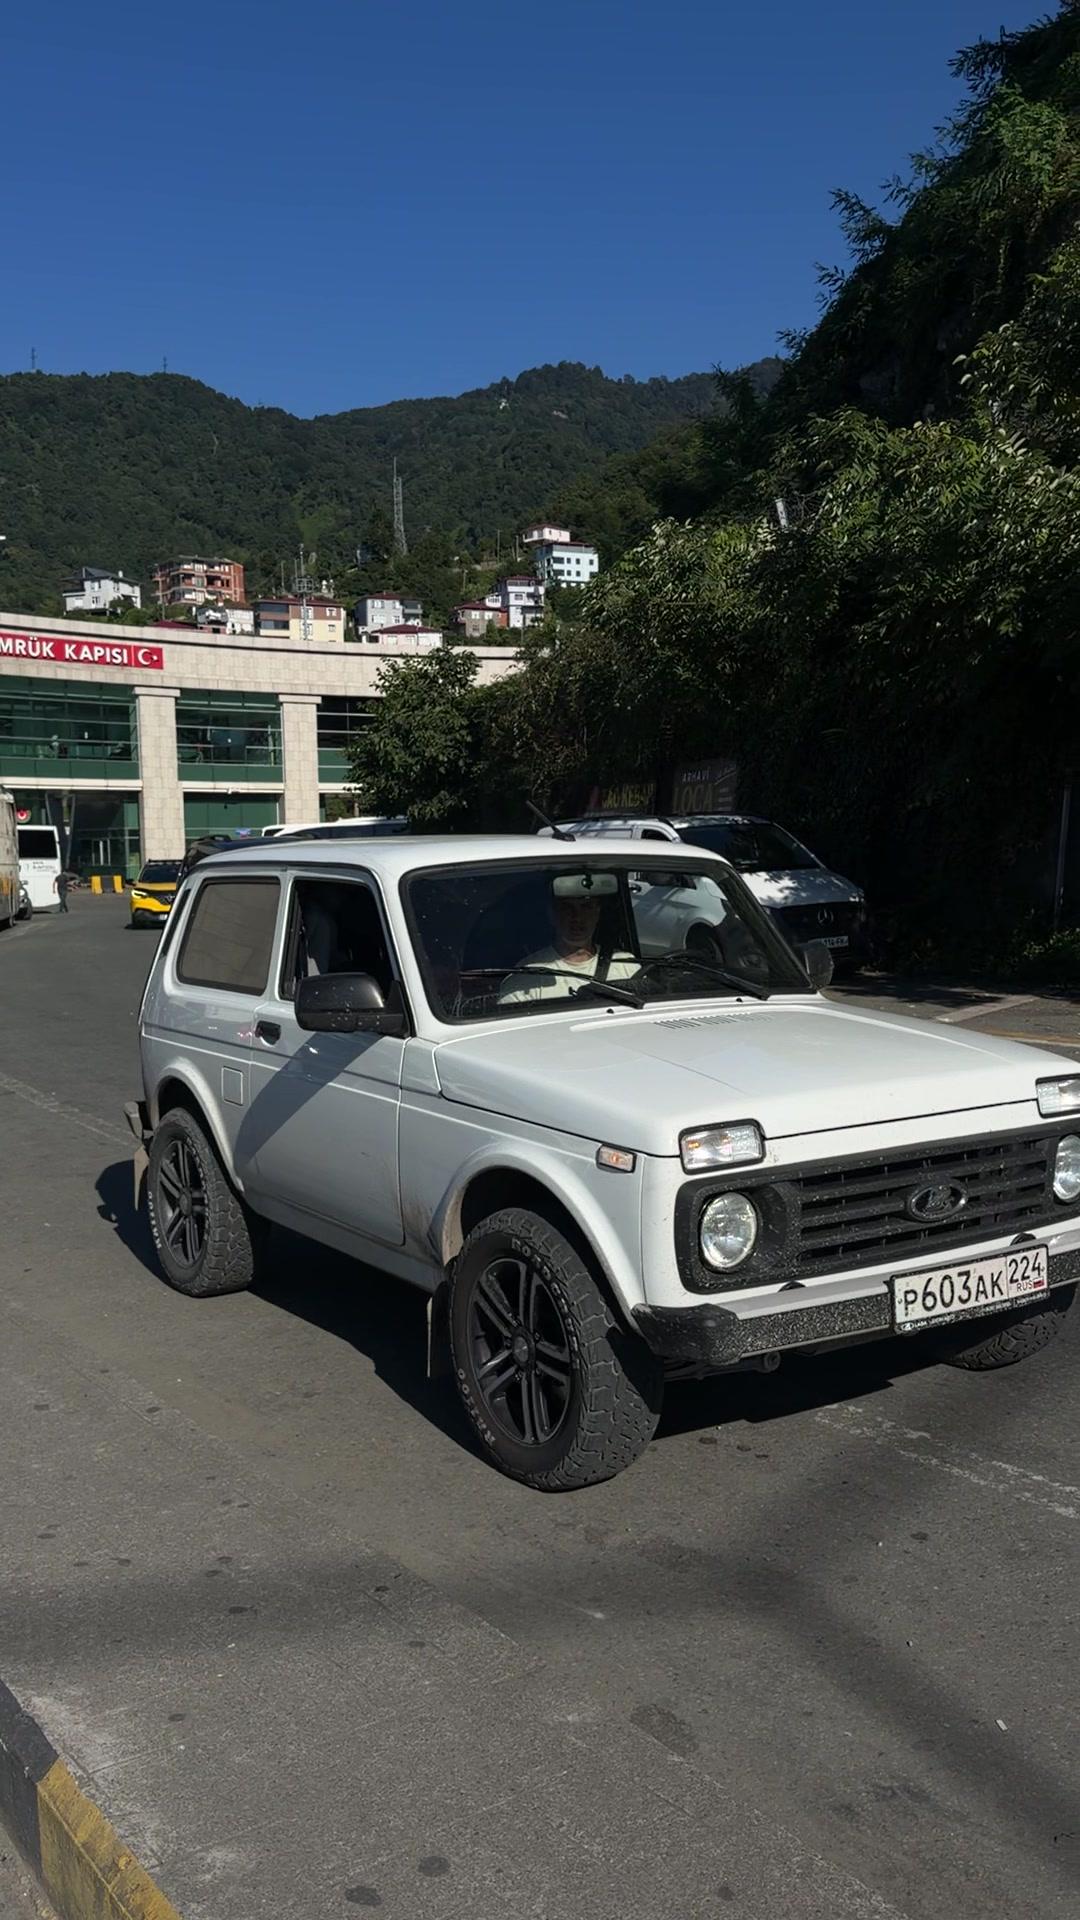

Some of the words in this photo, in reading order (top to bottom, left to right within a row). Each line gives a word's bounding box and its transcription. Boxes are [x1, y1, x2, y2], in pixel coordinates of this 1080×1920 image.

[64, 643, 128, 665] KAPISI
[904, 1270, 1004, 1317] P603AK
[1008, 1252, 1042, 1285] 224
[1016, 1280, 1034, 1293] RUS
